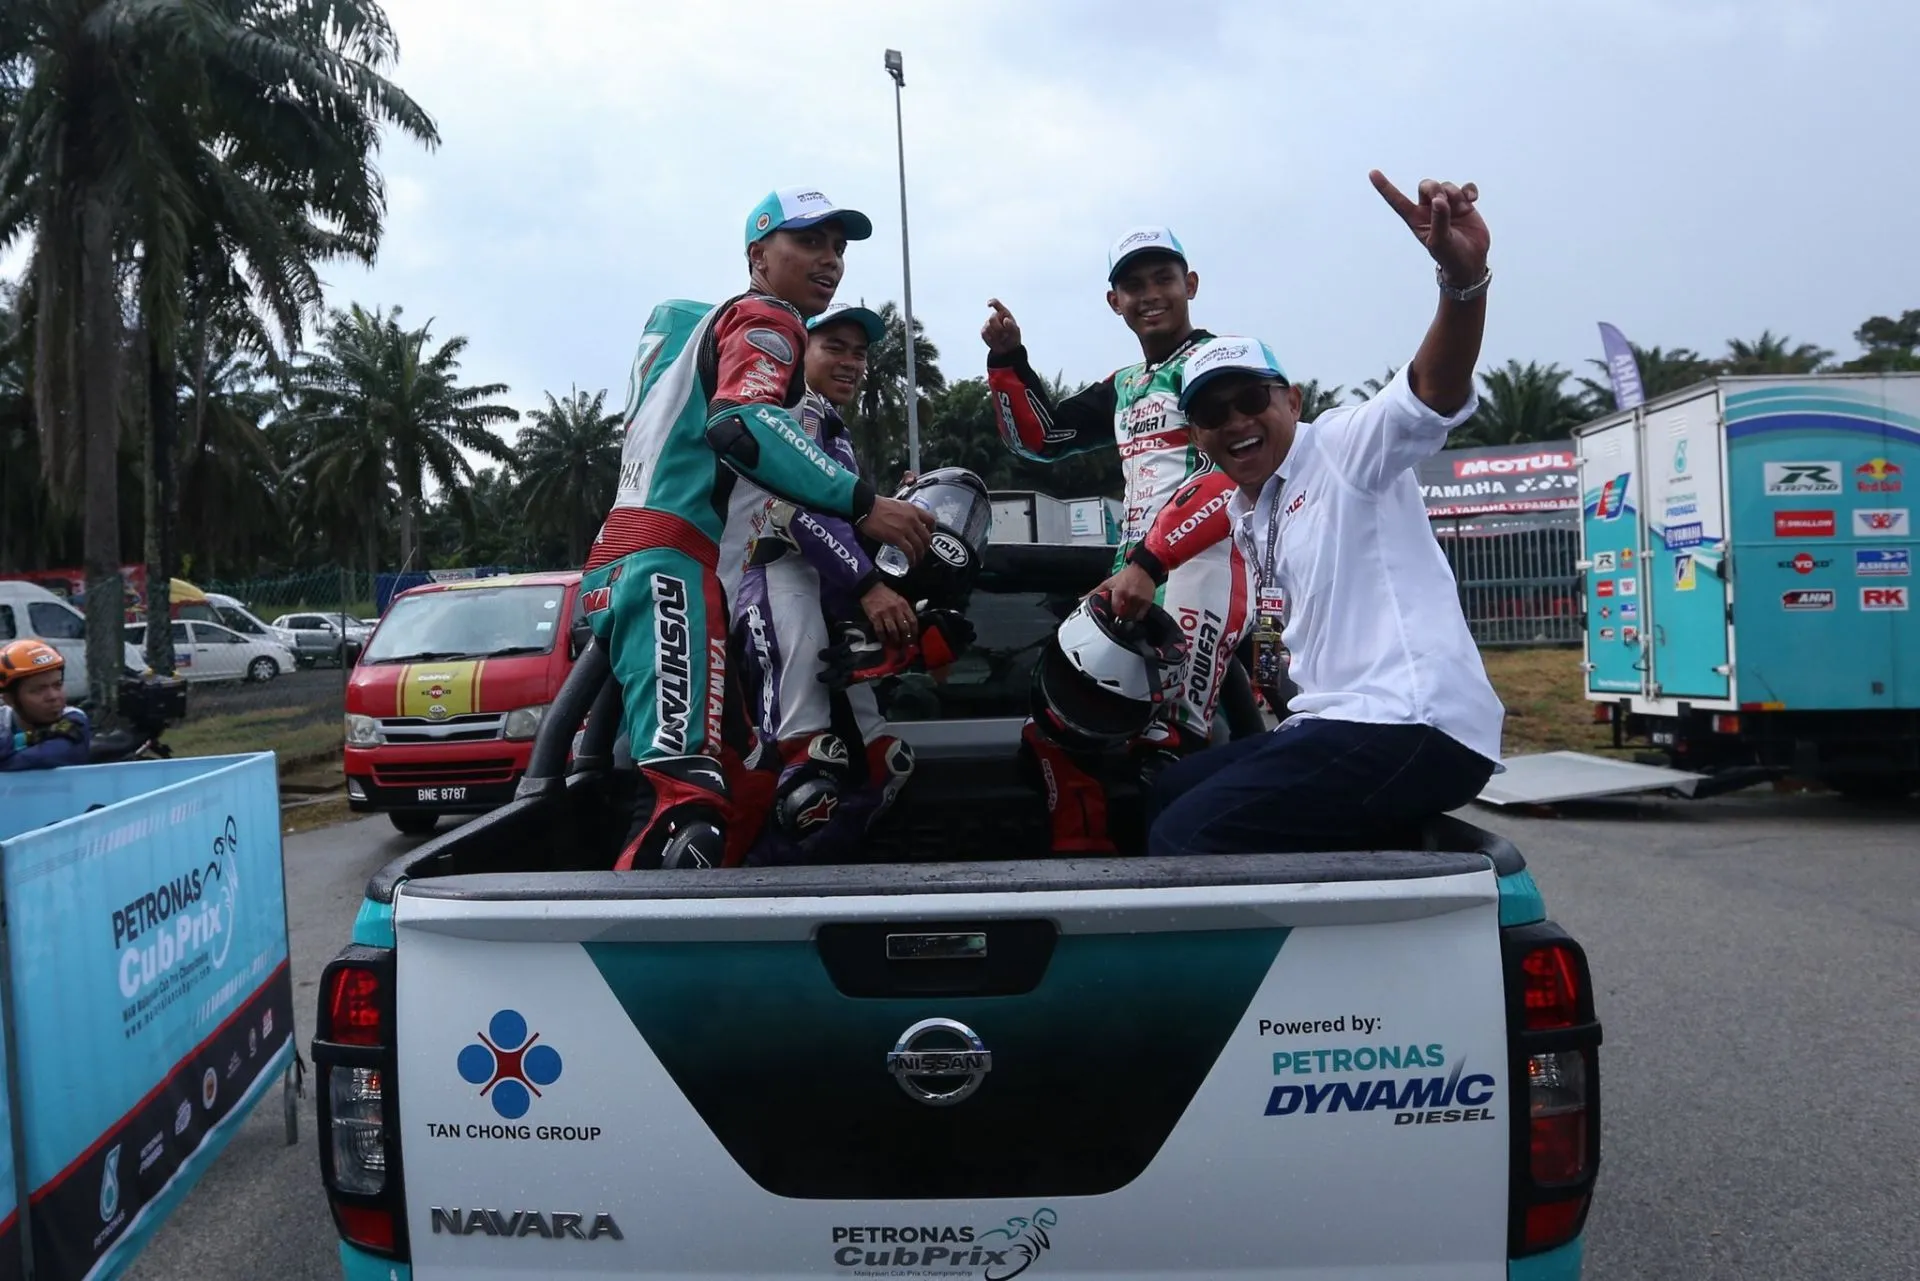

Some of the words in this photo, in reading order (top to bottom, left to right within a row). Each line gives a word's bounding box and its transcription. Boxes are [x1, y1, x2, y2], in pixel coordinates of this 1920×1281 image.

[756, 409, 836, 479] PETRONAS
[1460, 454, 1569, 476] MOTUL
[1419, 481, 1507, 498] YAMAHA
[1165, 487, 1236, 546] HONDA
[1426, 506, 1455, 517] OTUL
[797, 512, 860, 574] HONDA
[933, 537, 966, 560] Arai
[1864, 590, 1902, 605] RK
[652, 573, 691, 756] KUSHITANI
[418, 788, 438, 801] BNE
[441, 787, 466, 800] 8787
[112, 868, 201, 949] PETRONAS
[119, 904, 222, 998] CubPrix
[1259, 1016, 1345, 1036] Powered
[1352, 1015, 1382, 1034] by:
[896, 1055, 984, 1071] NISSAN
[1273, 1044, 1445, 1075] PETRONAS
[1263, 1054, 1496, 1117] DYNAMIC
[1394, 1108, 1496, 1126] DIESEL
[427, 1123, 460, 1138] TAN
[466, 1125, 531, 1140] CHONG
[536, 1126, 602, 1141] GROUP
[431, 1206, 625, 1241] NAVARA
[832, 1226, 975, 1244] PETRONAS
[834, 1246, 1009, 1267] CubPrix
